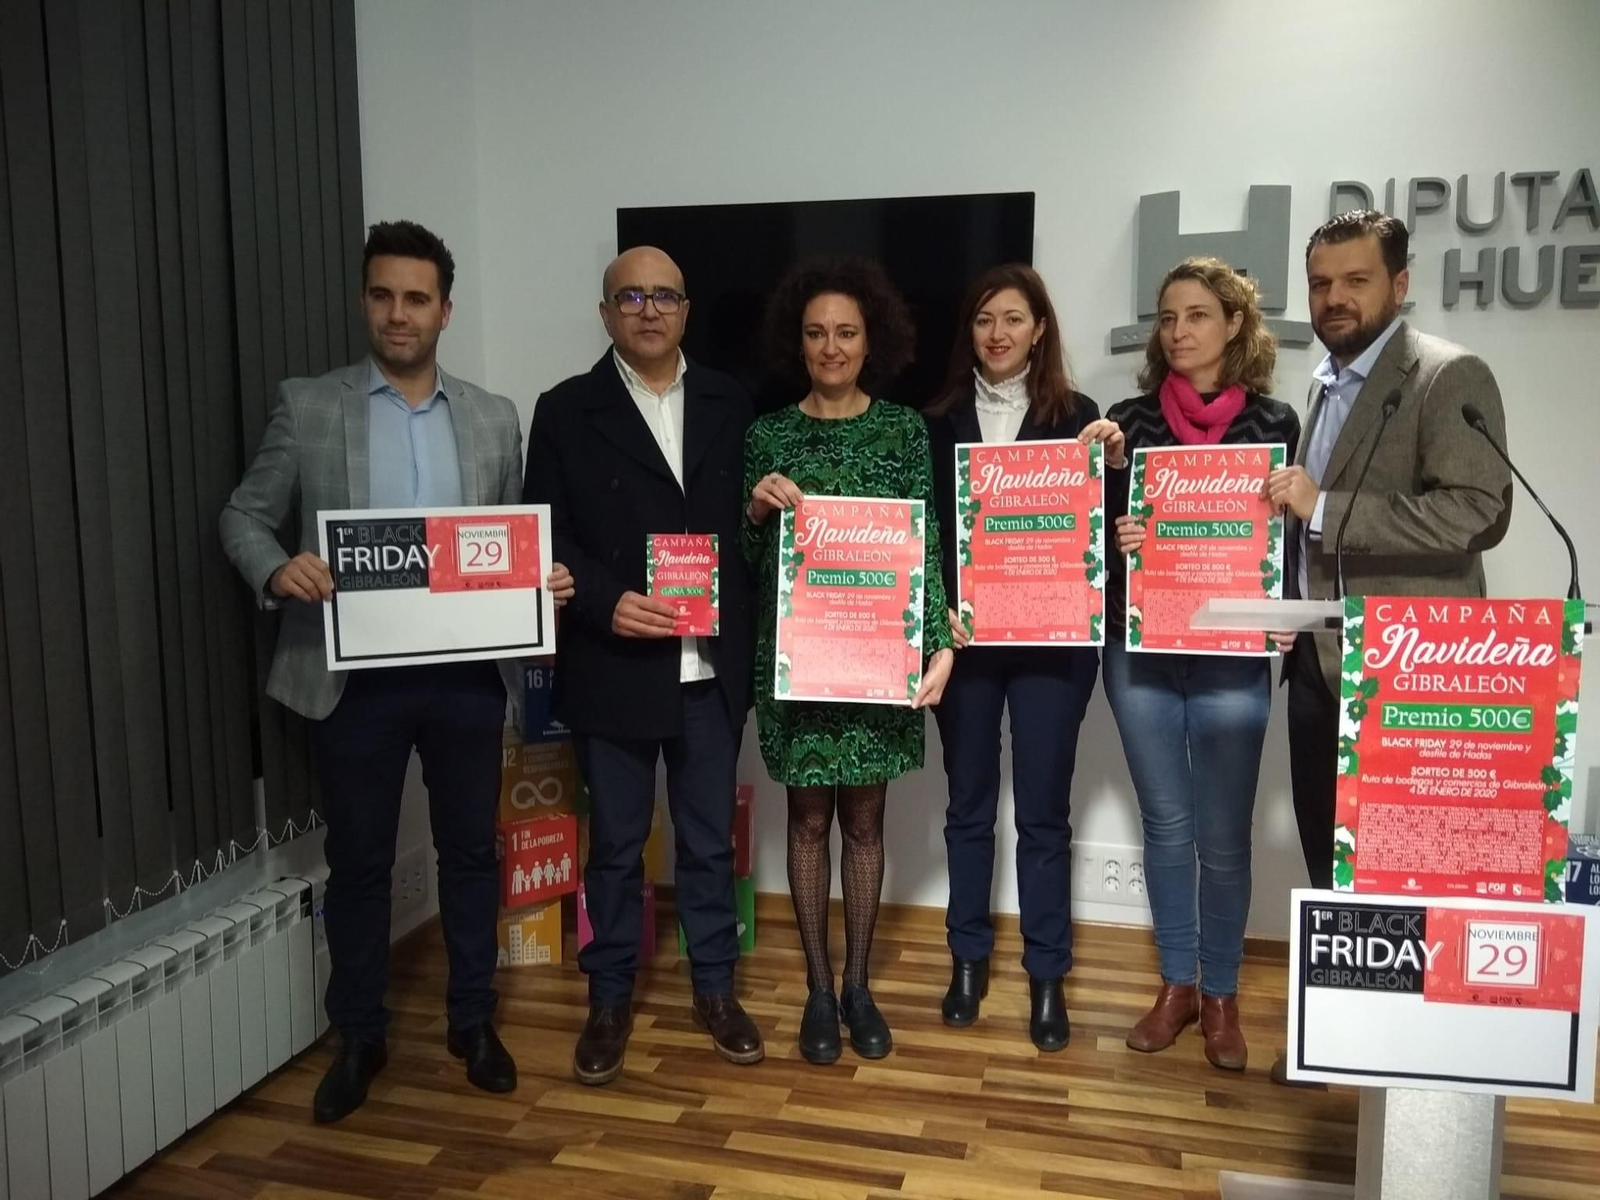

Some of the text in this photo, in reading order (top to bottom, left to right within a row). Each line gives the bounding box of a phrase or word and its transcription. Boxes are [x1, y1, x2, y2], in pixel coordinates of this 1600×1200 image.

[1444, 245, 1600, 308] HUE
[977, 447, 1082, 463] CAMPAÑA
[1153, 451, 1262, 467] CAMPAÑA
[971, 463, 1087, 495] Navideña
[1145, 468, 1264, 499] Navideña
[990, 493, 1069, 508] GIBRALEÓN
[1163, 499, 1247, 513] GIBRALEÓN
[802, 503, 904, 519] CAMPAÑA
[985, 515, 1074, 531] Premio 500€
[1157, 522, 1251, 536] Premio 500€
[358, 525, 423, 544] BLACK
[795, 517, 908, 548] Navideña
[654, 537, 710, 547] CAMPAÑA
[337, 544, 442, 573] FRIDAY
[467, 541, 502, 567] 29
[654, 550, 711, 567] Navideña
[813, 548, 892, 563] GIBRALEÓN
[340, 572, 420, 589] GIBRALEÓN
[657, 571, 708, 580] GIBRALEÓN
[808, 570, 895, 586] Premio 500€
[1376, 603, 1551, 625] CAMPAÑA
[1364, 624, 1556, 672] Navideña
[526, 669, 543, 689] 16
[1393, 673, 1526, 694] GIBRALEÓN
[1383, 706, 1531, 729] Premio 500€
[1382, 737, 1412, 748] BLACK
[1415, 738, 1446, 748] FRIDAY
[1450, 739, 1462, 749] 29
[1464, 740, 1475, 749] de
[1478, 741, 1522, 751] noviembre
[503, 748, 516, 767] 12
[1419, 748, 1492, 760] desfile de Hadas
[1411, 766, 1450, 777] SORTEO
[1453, 768, 1464, 778] DE
[1362, 773, 1380, 783] Ruta
[1382, 774, 1393, 784] de
[1396, 775, 1433, 787] bodegas
[1442, 778, 1486, 788] comercios
[1489, 779, 1500, 789] de
[1503, 779, 1546, 790] Gibraleón
[1416, 786, 1428, 795] DE
[1430, 787, 1459, 797] ENERO
[1461, 787, 1472, 797] DE
[1474, 788, 1497, 798] 2020
[512, 832, 517, 852] 1
[521, 830, 531, 839] FIN
[521, 832, 564, 850] DE LA POBREZA
[1566, 861, 1581, 882] 17
[1338, 911, 1420, 937] BLACK
[1469, 928, 1538, 942] NOVIEMBRE
[1311, 934, 1444, 972] FRIDAY
[1477, 944, 1528, 977] 29
[1311, 969, 1414, 990] GIBRALEÓN
